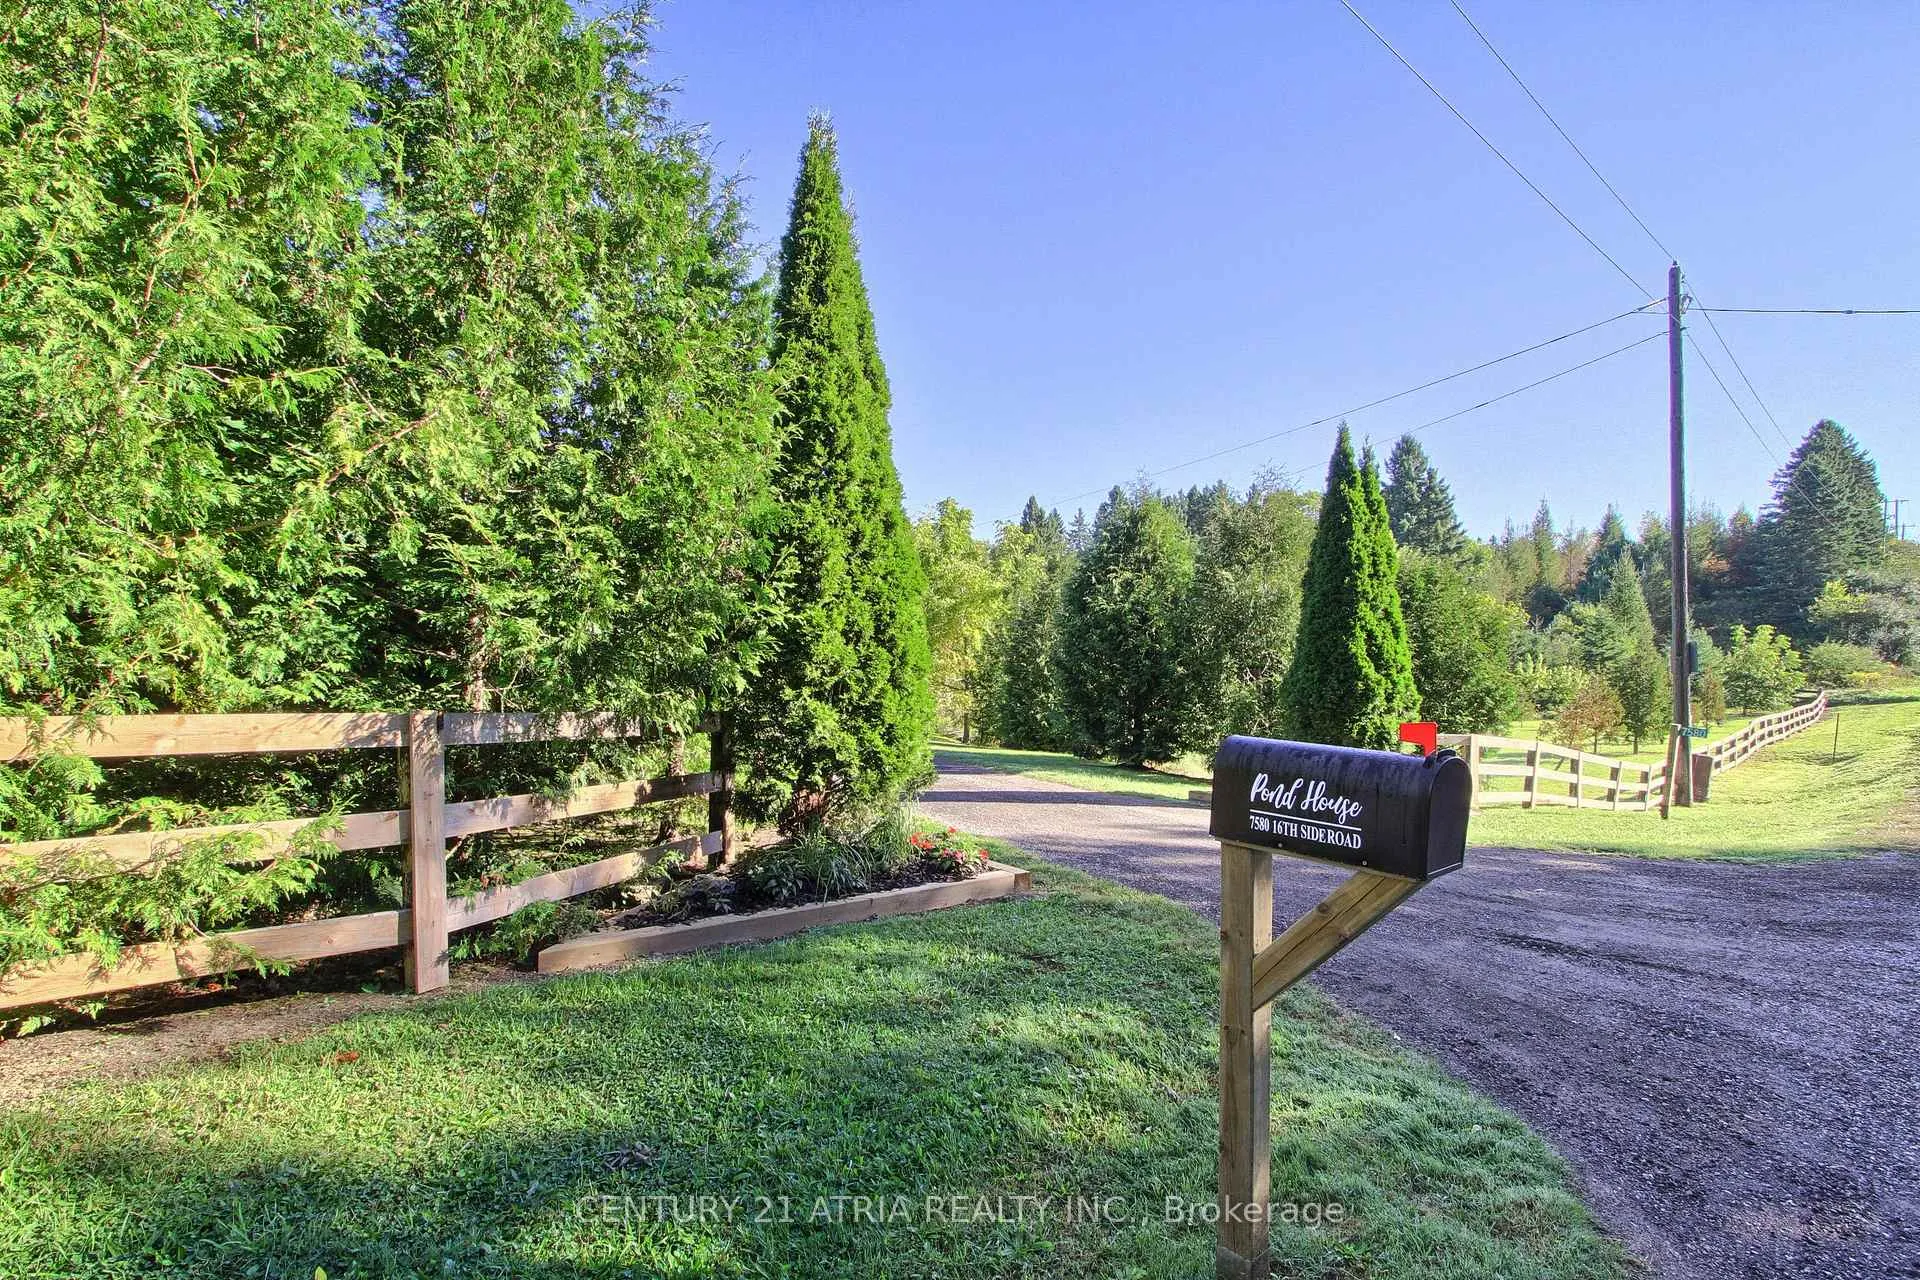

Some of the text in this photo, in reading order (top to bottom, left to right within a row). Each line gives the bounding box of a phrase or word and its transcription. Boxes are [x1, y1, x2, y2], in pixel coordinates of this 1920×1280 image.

[1250, 772, 1363, 824] Pond House
[1249, 815, 1362, 849] 7580 16TH SIDEROAD
